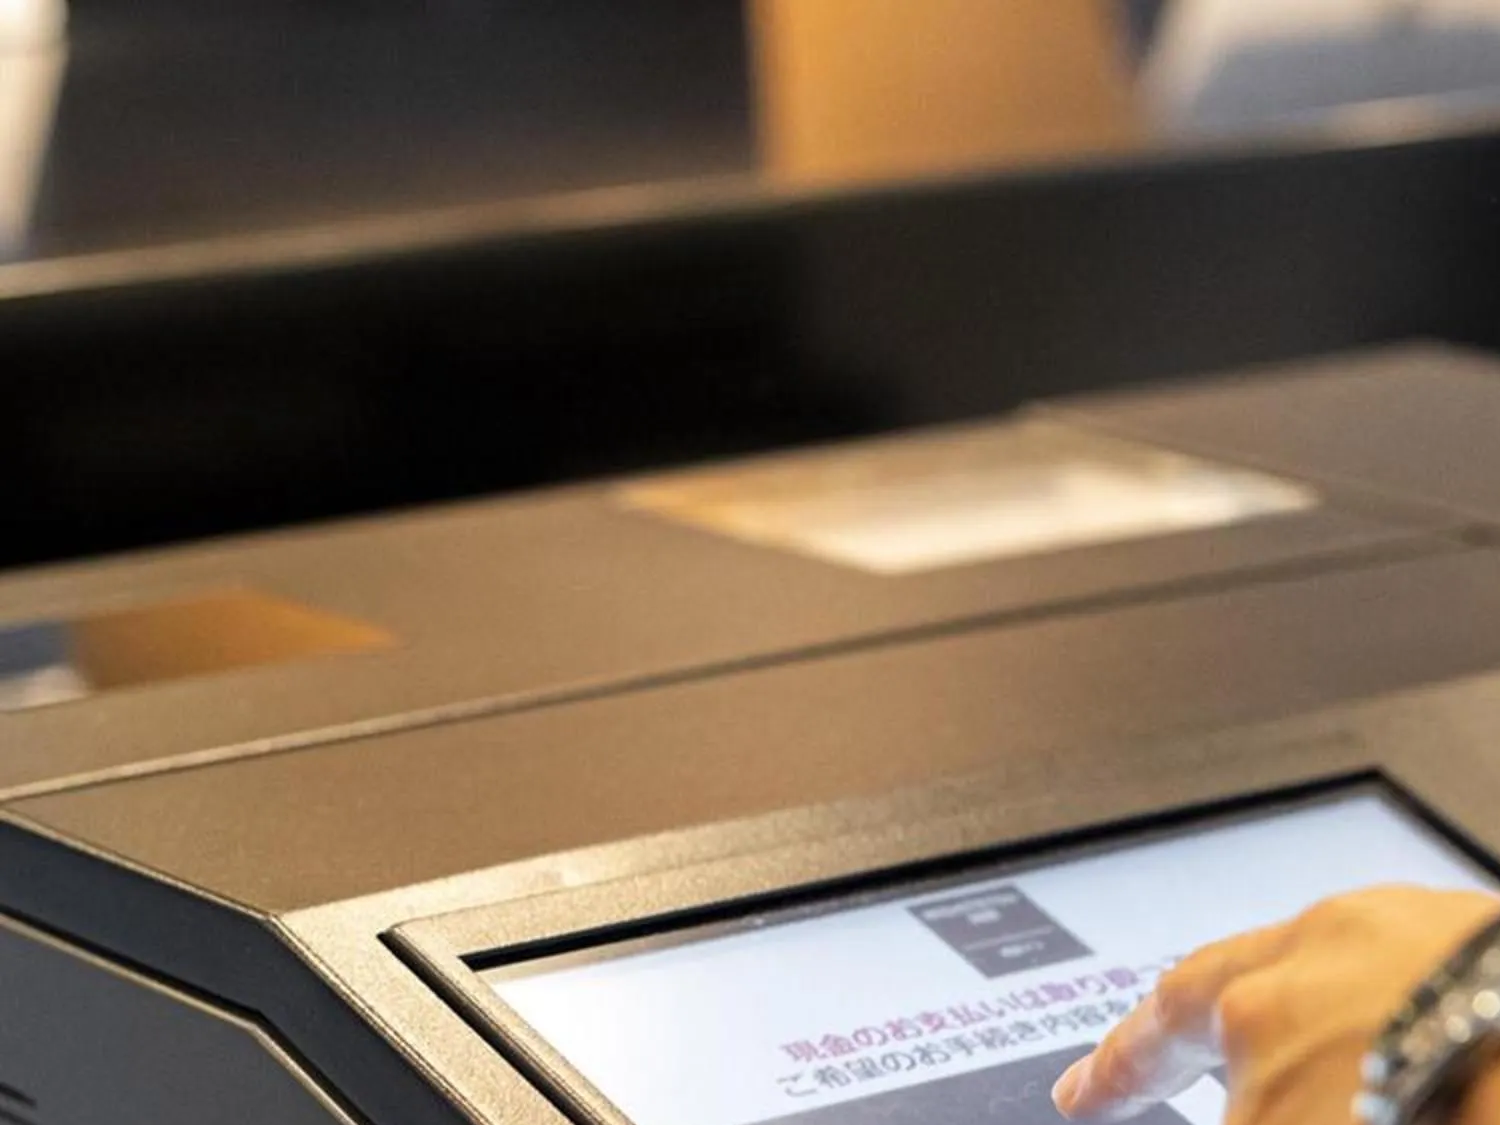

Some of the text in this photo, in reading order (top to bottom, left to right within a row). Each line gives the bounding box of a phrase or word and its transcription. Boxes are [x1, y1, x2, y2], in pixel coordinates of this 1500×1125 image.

[776, 991, 1146, 1097] ご希望のお手続き内容を
